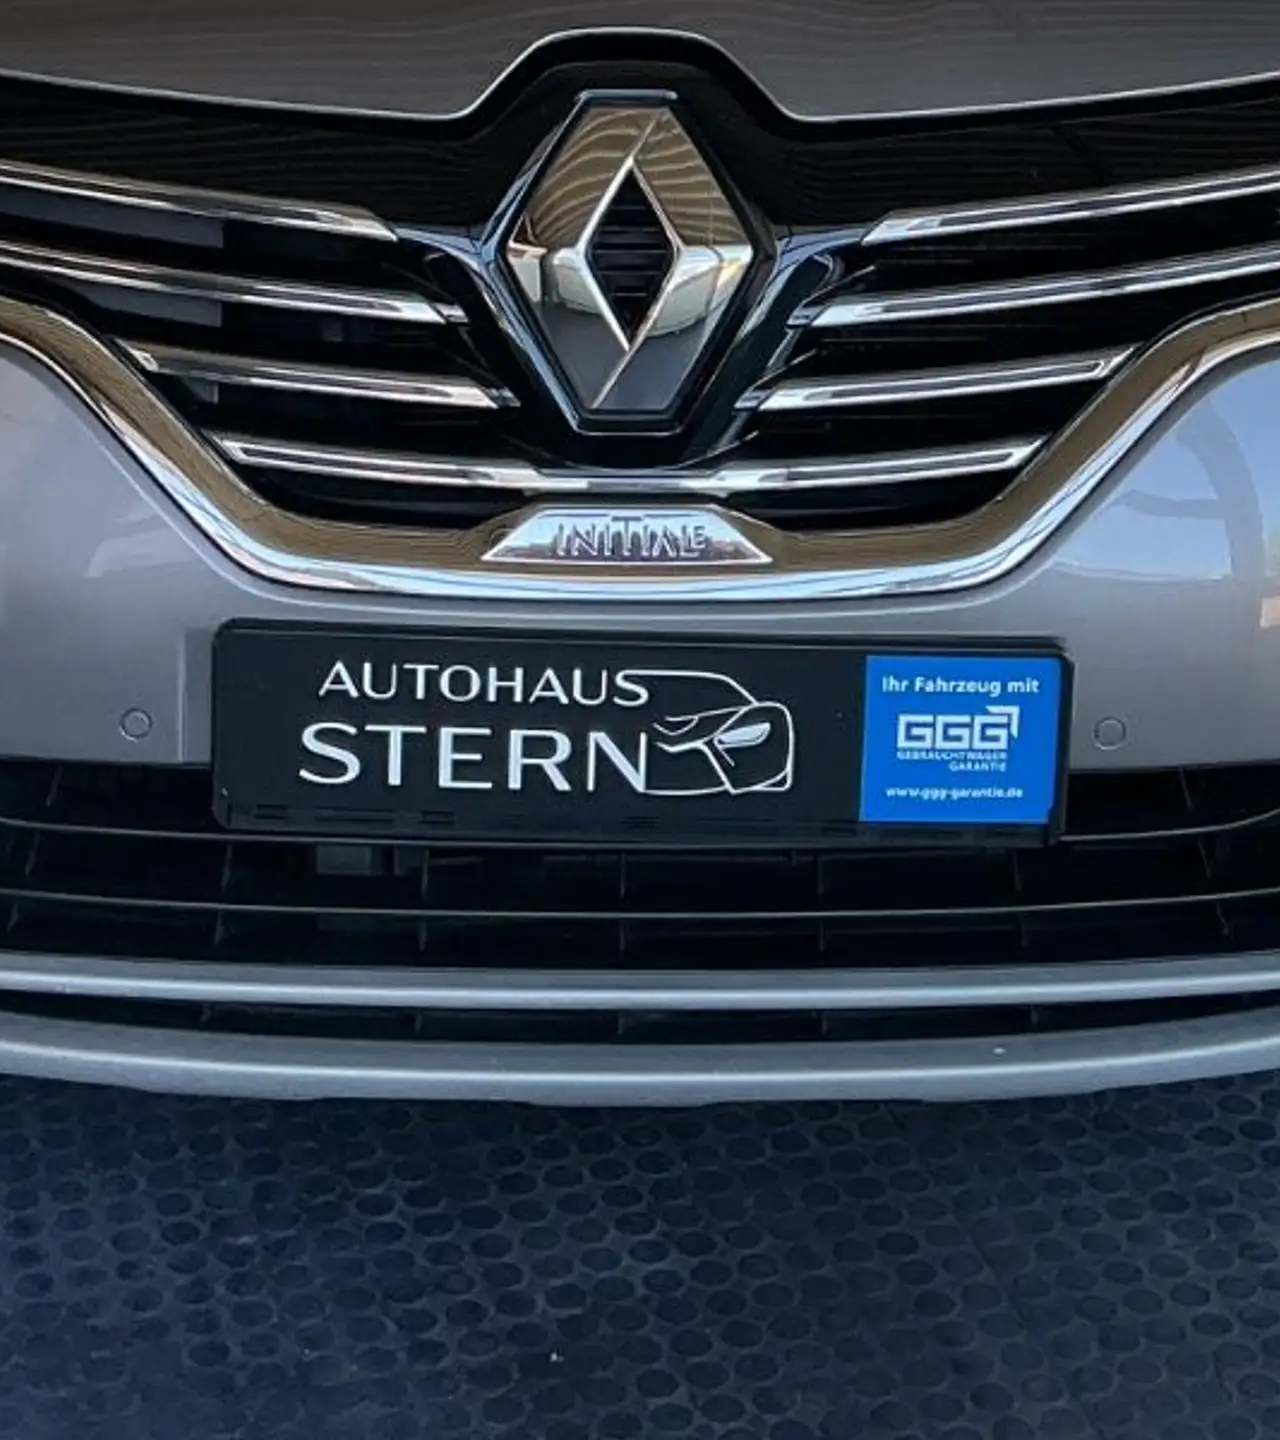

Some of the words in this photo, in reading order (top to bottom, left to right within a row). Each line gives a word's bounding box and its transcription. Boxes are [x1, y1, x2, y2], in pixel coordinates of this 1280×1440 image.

[318, 661, 650, 708] AUTOHAUS
[882, 675, 907, 693] Ihr
[914, 676, 1002, 698] Fahrzeug
[1007, 676, 1040, 694] mit
[897, 713, 1009, 750] GGG
[297, 722, 648, 793] STERN
